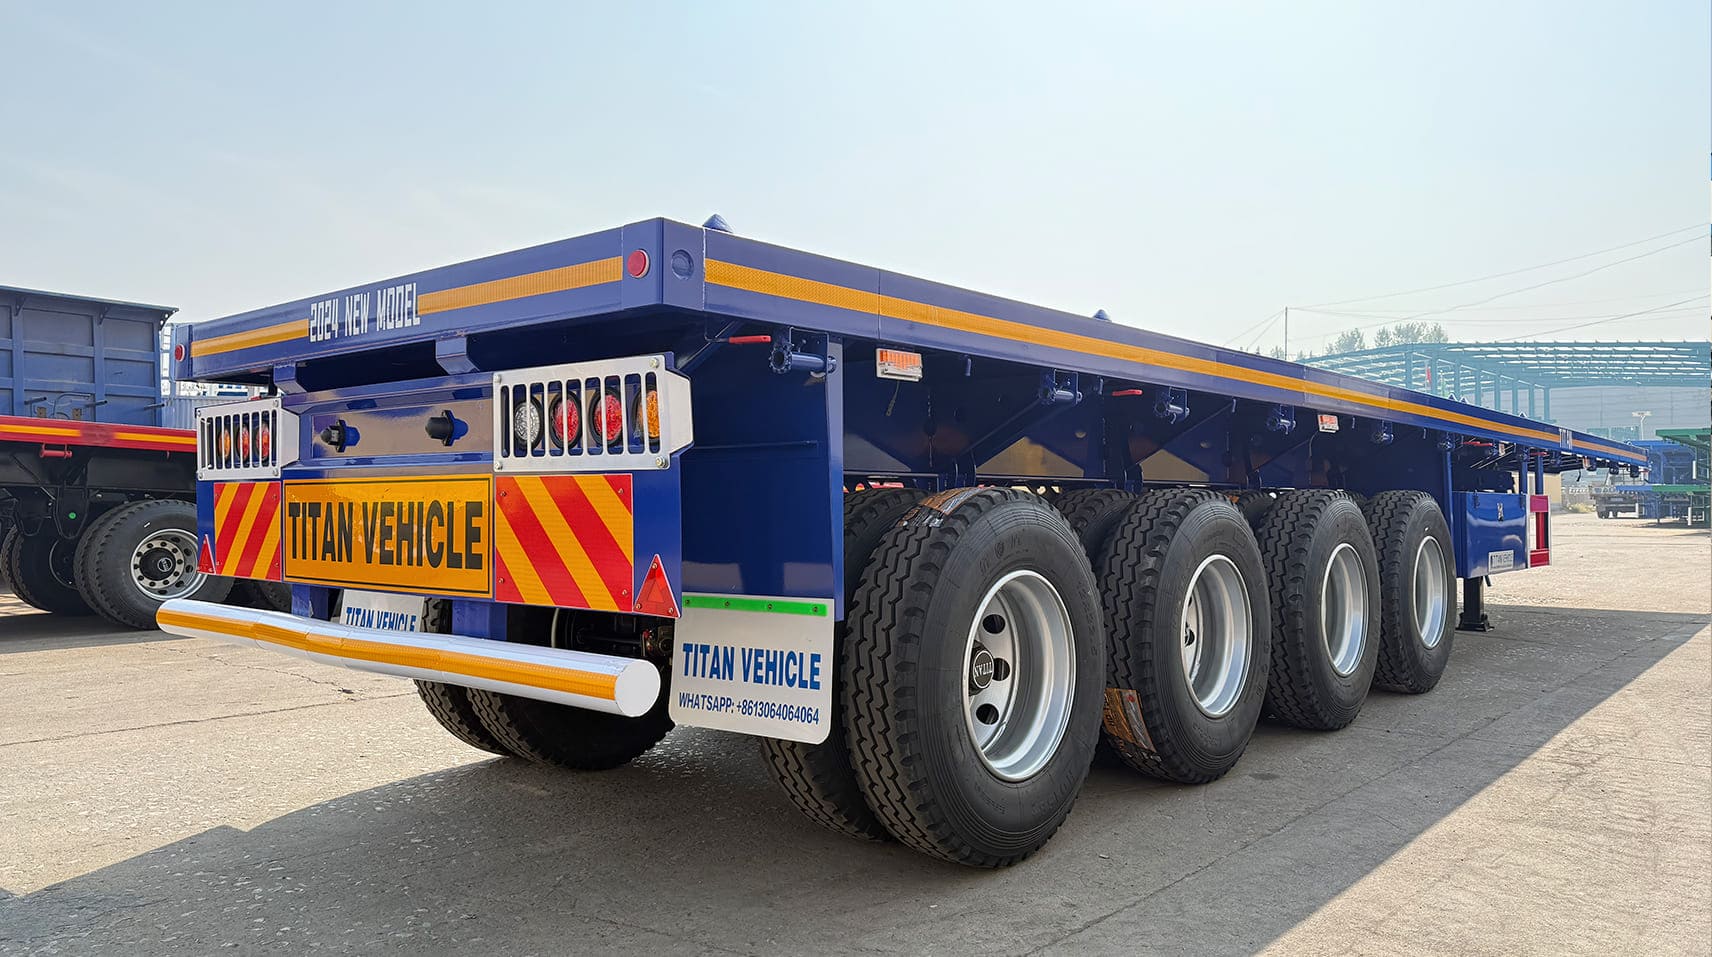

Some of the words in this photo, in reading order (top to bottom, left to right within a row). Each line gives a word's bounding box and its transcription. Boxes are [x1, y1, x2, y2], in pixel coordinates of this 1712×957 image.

[310, 299, 339, 342] 2024
[345, 292, 370, 337] NEW
[376, 282, 421, 332] MODEL
[288, 501, 354, 563] TITAN
[362, 499, 483, 570] VEHICLE
[346, 606, 374, 629] TITAN
[682, 643, 735, 681] TITAN
[741, 647, 822, 690] VEHICLE
[974, 661, 994, 678] TITAN
[679, 692, 735, 714] WHATSAPP:
[736, 699, 820, 725] +8613064064064
